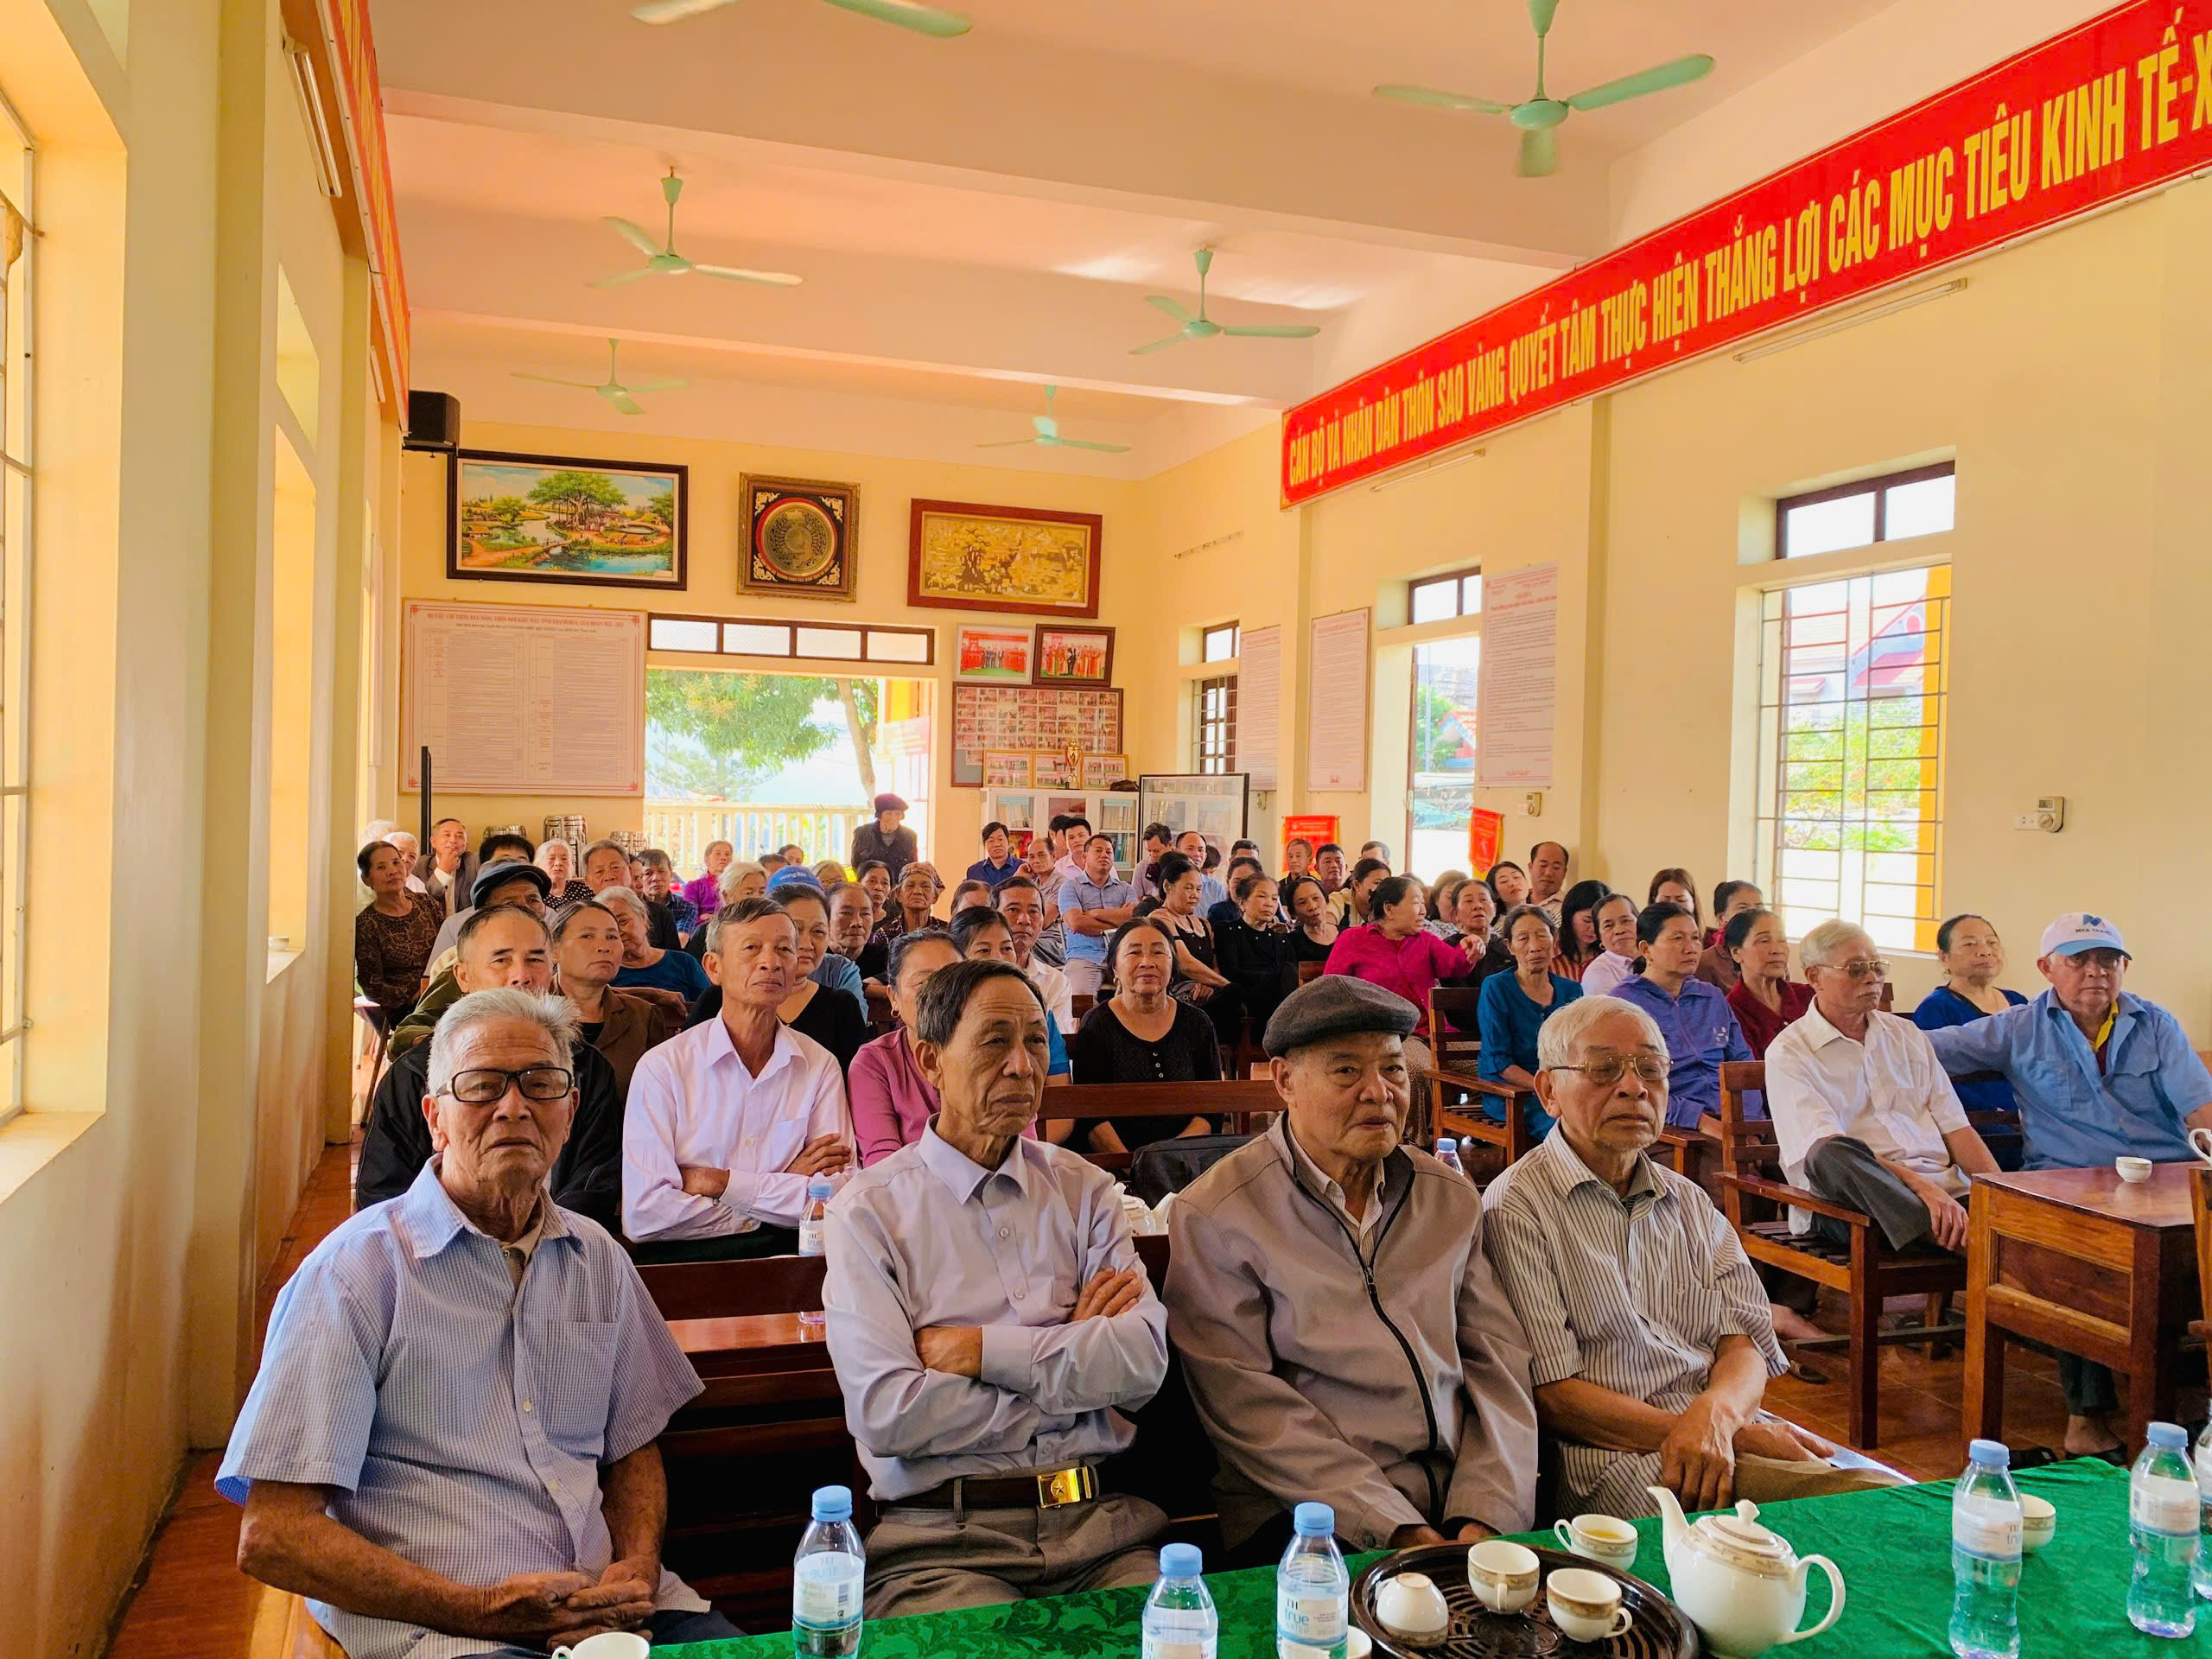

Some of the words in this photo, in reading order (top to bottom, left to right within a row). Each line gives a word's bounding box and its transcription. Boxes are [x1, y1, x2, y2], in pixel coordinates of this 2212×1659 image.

[1311, 416, 1325, 486] BỘ
[1326, 409, 1341, 473] VÀ
[1374, 386, 1400, 453] DÂN
[1402, 369, 1434, 442] THÔN
[1437, 364, 1464, 429] SAO
[1467, 342, 1505, 416] VÀNG
[1510, 302, 1556, 406] QUYẾT
[1560, 299, 1597, 380] TÂM
[1600, 278, 1647, 370] THỰC
[1651, 251, 1699, 352] HIỆN
[1705, 214, 1777, 322] THẮNG
[1783, 200, 1821, 303] LỢI
[1828, 168, 1881, 274] CÁC
[1889, 146, 1954, 258] MỤC
[1964, 102, 2032, 220] TIÊU
[2041, 67, 2126, 191] KINH
